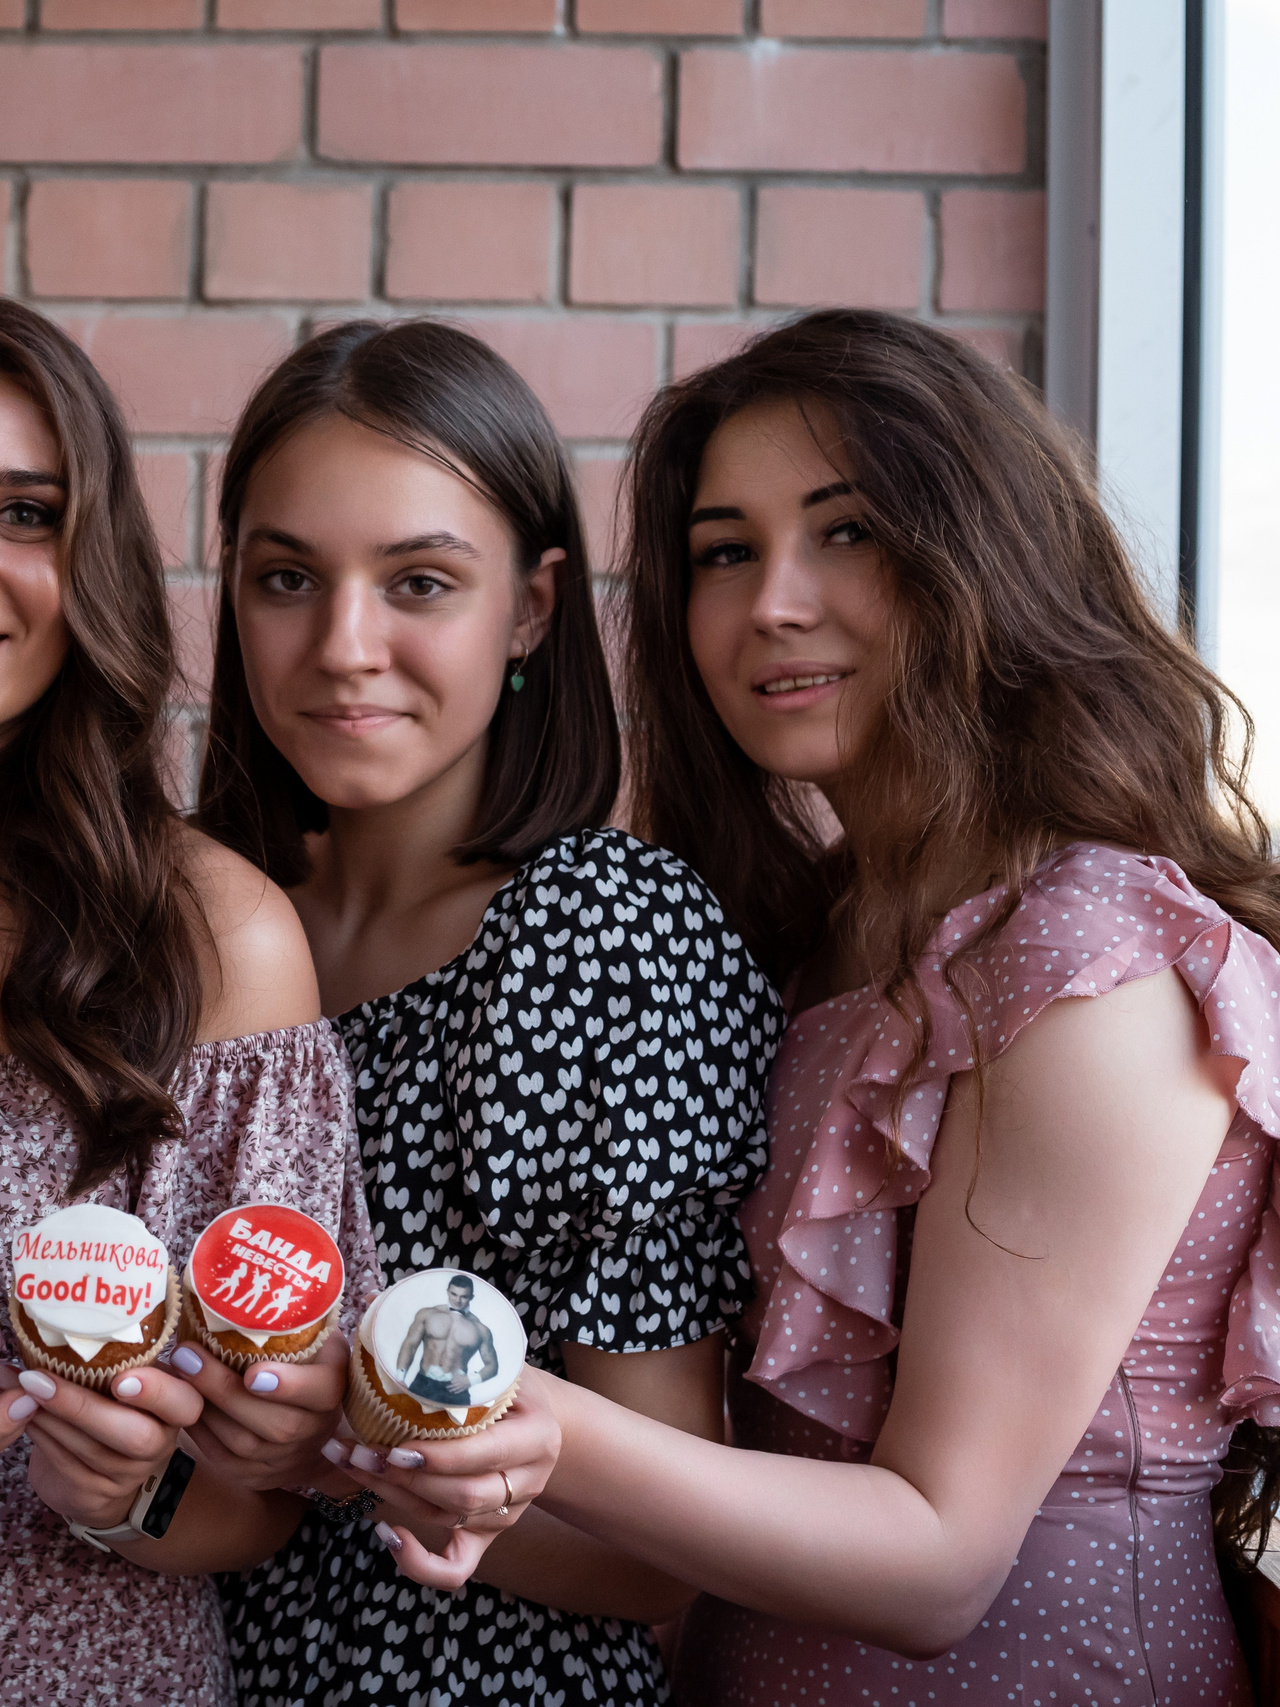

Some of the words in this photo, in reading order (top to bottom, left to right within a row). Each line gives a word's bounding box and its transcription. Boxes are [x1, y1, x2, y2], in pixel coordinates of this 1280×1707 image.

[14, 1232, 164, 1274] Мельникова,
[229, 1218, 331, 1283] БАНДА
[230, 1243, 312, 1291] НЕВЕСТЫ
[16, 1273, 88, 1302] Good
[95, 1277, 152, 1316] bay!
